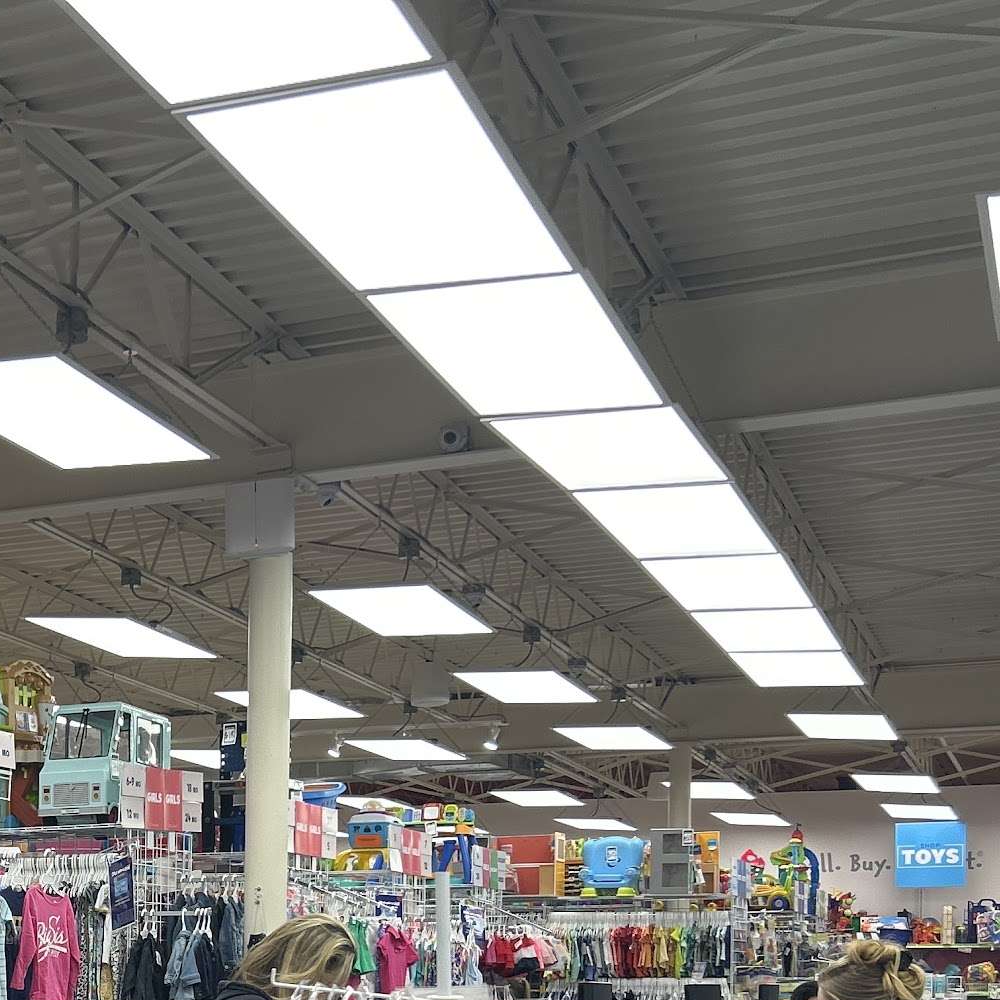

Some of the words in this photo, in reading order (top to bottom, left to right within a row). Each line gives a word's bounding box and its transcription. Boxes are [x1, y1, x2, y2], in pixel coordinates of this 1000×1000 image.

[126, 777, 135, 787] 6-9
[147, 792, 163, 804] GIRLS
[165, 793, 181, 806] GIRLS
[901, 848, 960, 865] TOYS
[849, 853, 892, 878] Buy.
